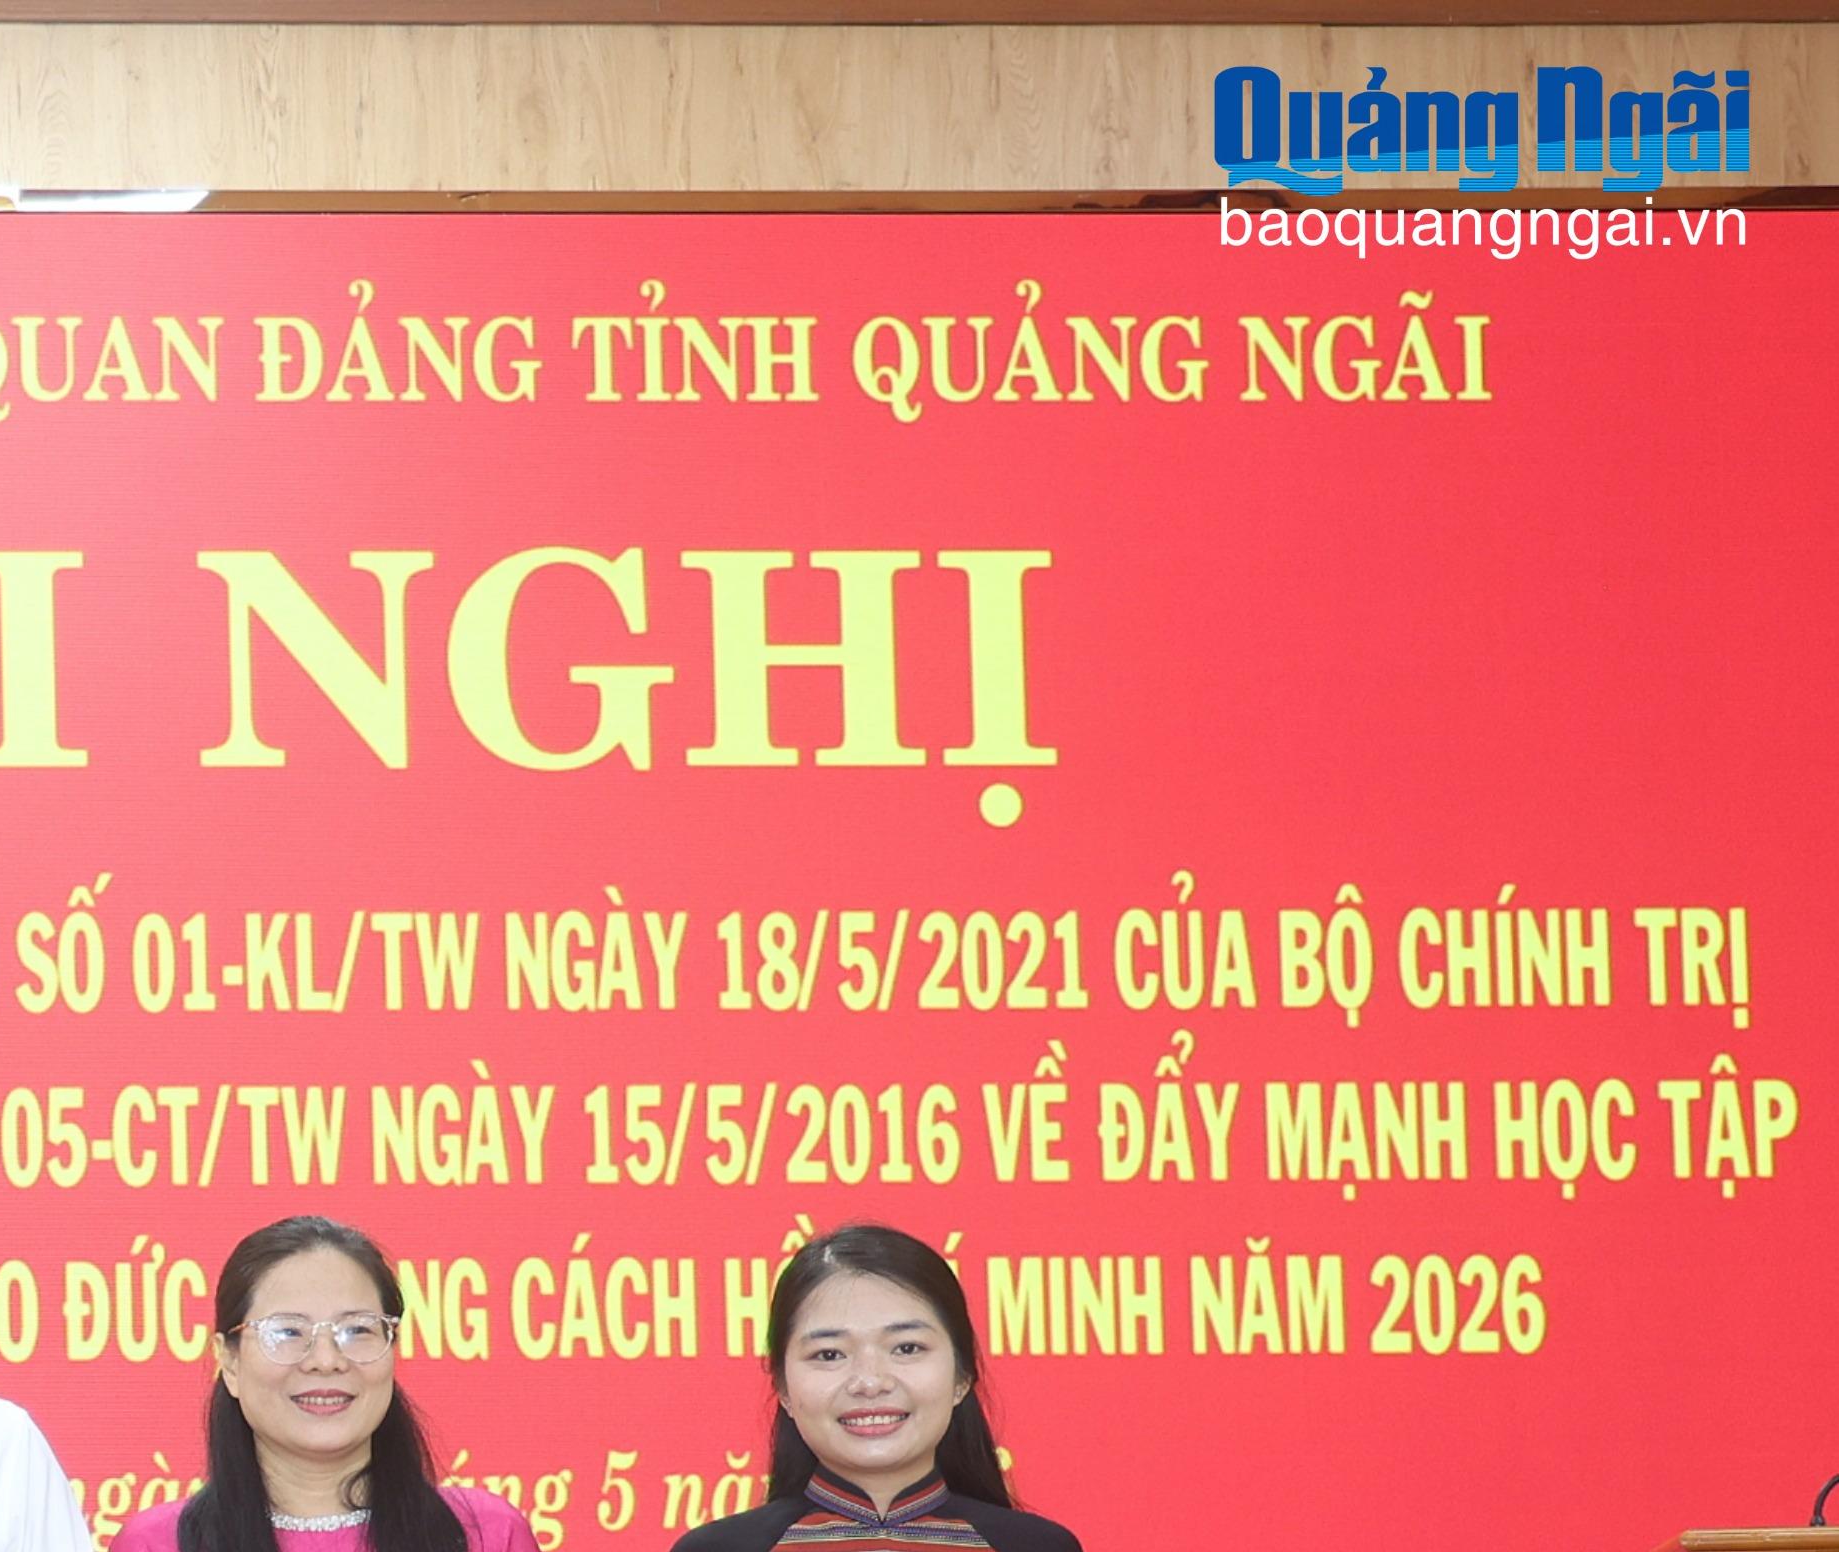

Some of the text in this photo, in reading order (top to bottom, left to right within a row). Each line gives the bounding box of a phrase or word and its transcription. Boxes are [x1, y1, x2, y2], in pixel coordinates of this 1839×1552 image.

[254, 278, 542, 402] ĐẢNG
[572, 280, 819, 401] TỈNH
[853, 280, 1209, 422] QUẢNG
[1239, 291, 1491, 401] NGÃI
[196, 546, 1058, 827] NGHỊ
[15, 872, 112, 1014] SỐ
[132, 910, 480, 1014] 01-KL/TW
[505, 885, 688, 1012] NGÀY
[717, 909, 1089, 1011] 18/5/2021
[1115, 870, 1256, 1010] CỦA
[1279, 884, 1373, 1028] BỘ
[1399, 884, 1610, 1008] CHÍNH
[1634, 908, 1749, 1028] TRỊ
[0, 1084, 346, 1188] 05-CT/TW
[371, 1059, 555, 1186] NGÀY
[584, 1082, 961, 1185] 15/5/2016
[982, 1040, 1070, 1181] VỀ
[1098, 1029, 1239, 1181] ĐẨY
[1265, 1082, 1467, 1200] MẠNH
[1494, 1079, 1636, 1199] HỌC
[1659, 1054, 1797, 1198] TẬP
[511, 1232, 698, 1360] CÁCH
[987, 1256, 1164, 1355] MINH
[1191, 1237, 1345, 1354] NĂM
[1371, 1255, 1545, 1354] 2026
[597, 1450, 637, 1531] 5
[663, 1451, 771, 1530] nă
